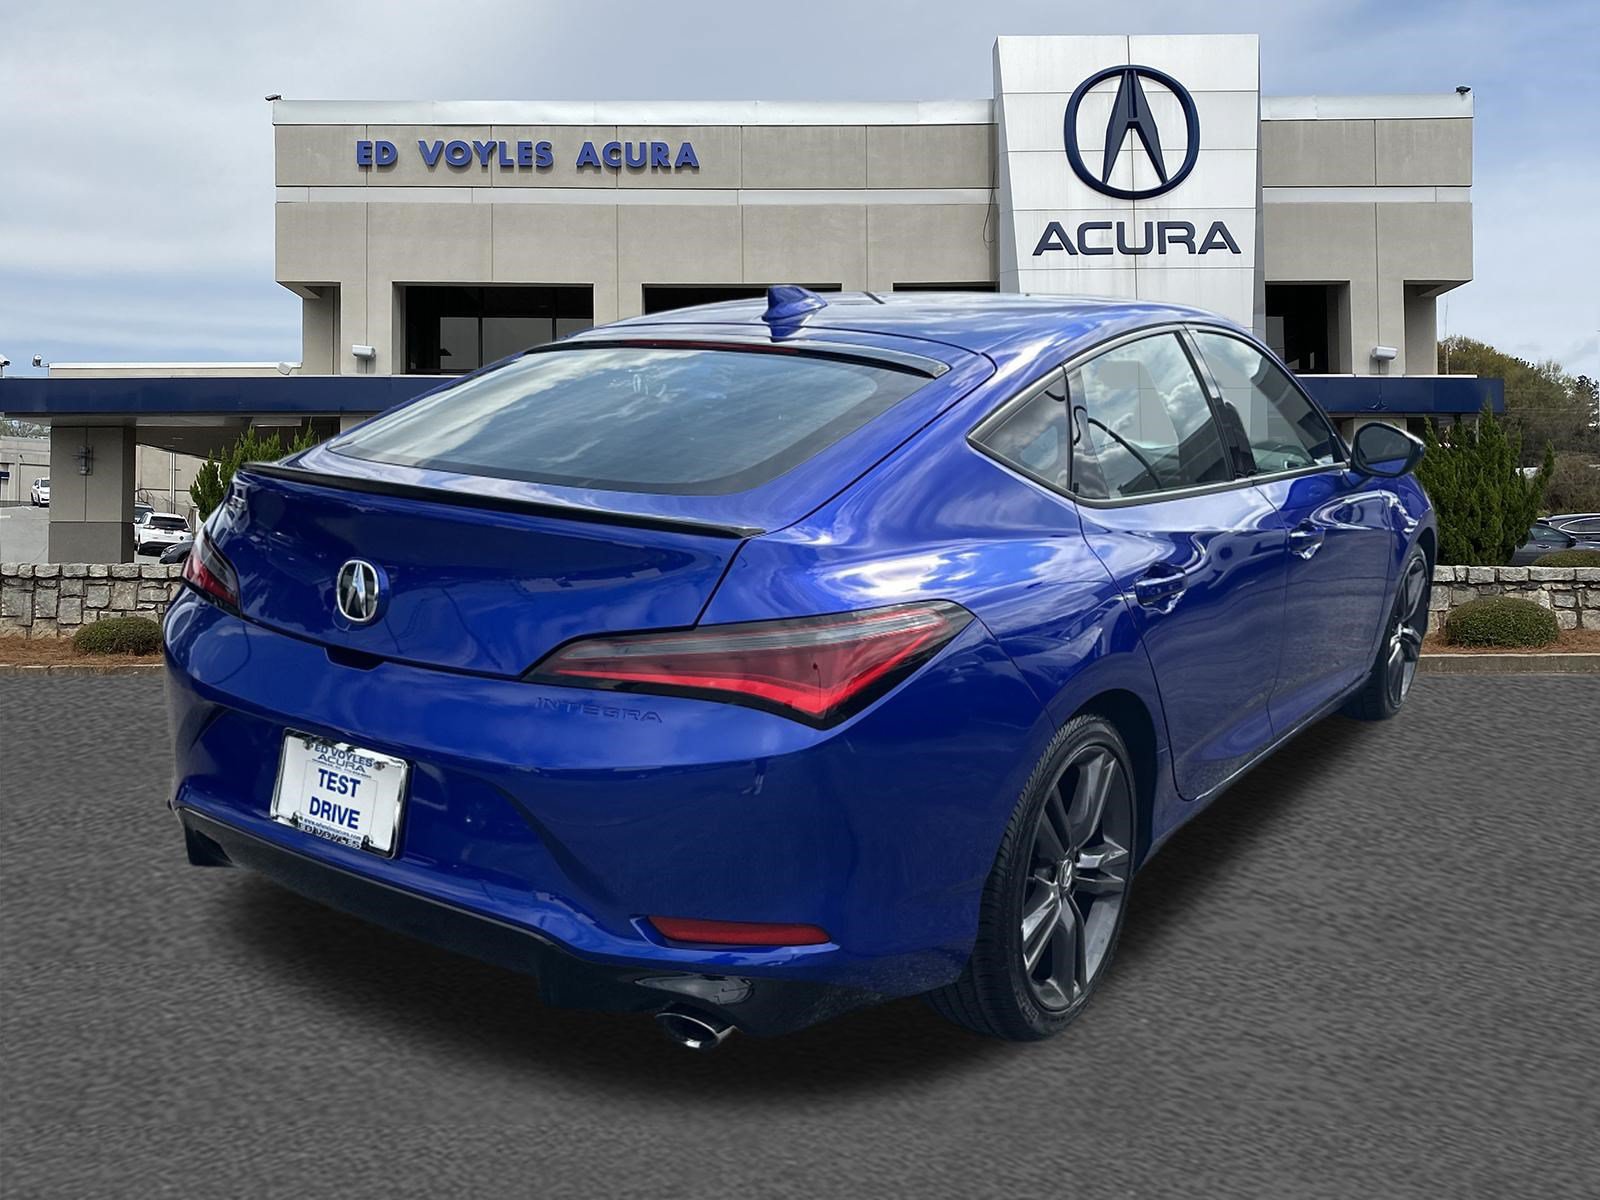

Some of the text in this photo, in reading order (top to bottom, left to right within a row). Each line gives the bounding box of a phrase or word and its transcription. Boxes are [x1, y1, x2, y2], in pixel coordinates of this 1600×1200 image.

[356, 140, 700, 168] ED VOYLES ACURA
[1032, 221, 1242, 256] ACURA
[534, 697, 662, 723] INTEGRA
[314, 743, 375, 767] ED VOYLES
[318, 754, 366, 773] ACURA
[318, 768, 361, 798] TEST
[309, 796, 361, 830] DRIVE
